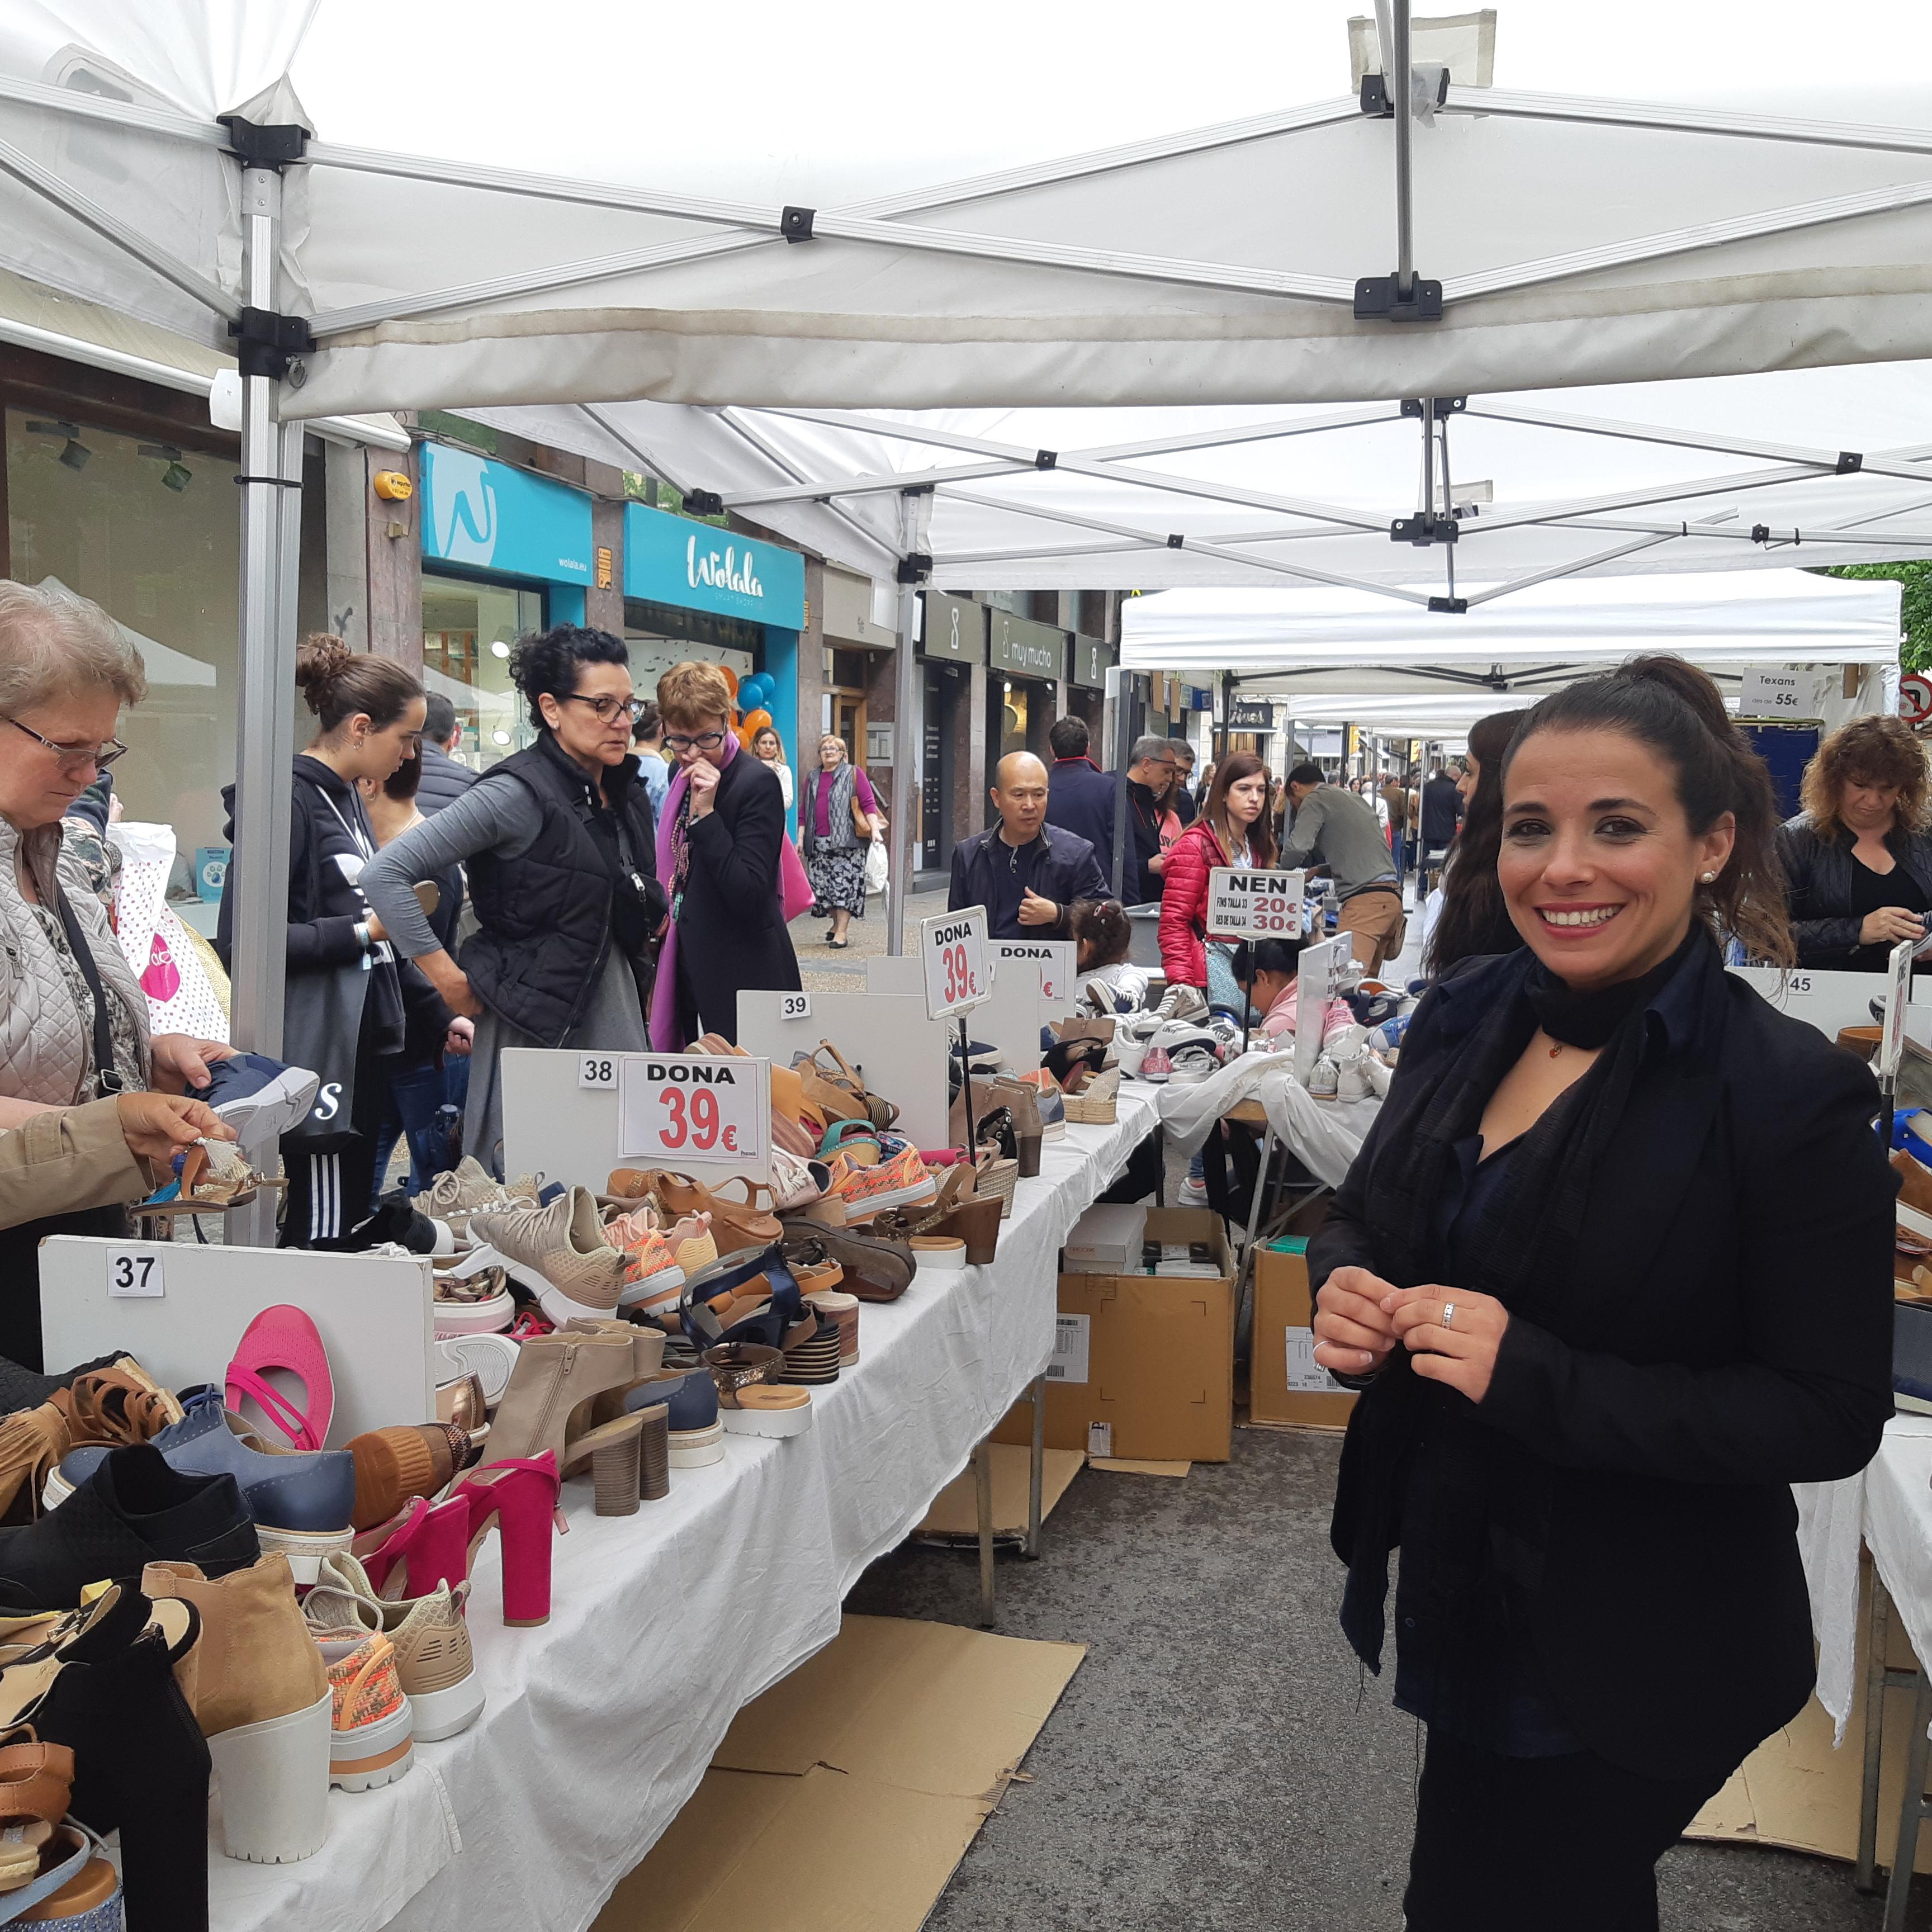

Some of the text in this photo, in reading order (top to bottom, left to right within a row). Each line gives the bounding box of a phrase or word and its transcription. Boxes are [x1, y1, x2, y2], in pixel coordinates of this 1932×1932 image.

[559, 558, 586, 571] wolala.eu
[688, 535, 764, 598] Wolala
[1011, 643, 1051, 667] muy mucho
[1760, 675, 1795, 686] Texans
[1775, 693, 1799, 706] 55€
[1229, 875, 1287, 894] NEN
[1216, 897, 1297, 914] FINS TALLA 33 20€
[1224, 915, 1229, 926] DE
[1229, 916, 1240, 926] TALLA
[1242, 916, 1247, 926] 34
[1253, 915, 1296, 932] 30€
[935, 922, 972, 946] DONA
[1001, 947, 1053, 959] DONA
[943, 944, 977, 1003] 39€
[1789, 977, 1811, 992] 45
[785, 997, 806, 1014] 39
[584, 1060, 613, 1082] 38
[647, 1063, 736, 1085] DONA
[315, 1082, 342, 1120] S
[659, 1086, 738, 1152] 39€
[115, 1256, 155, 1289] 37
